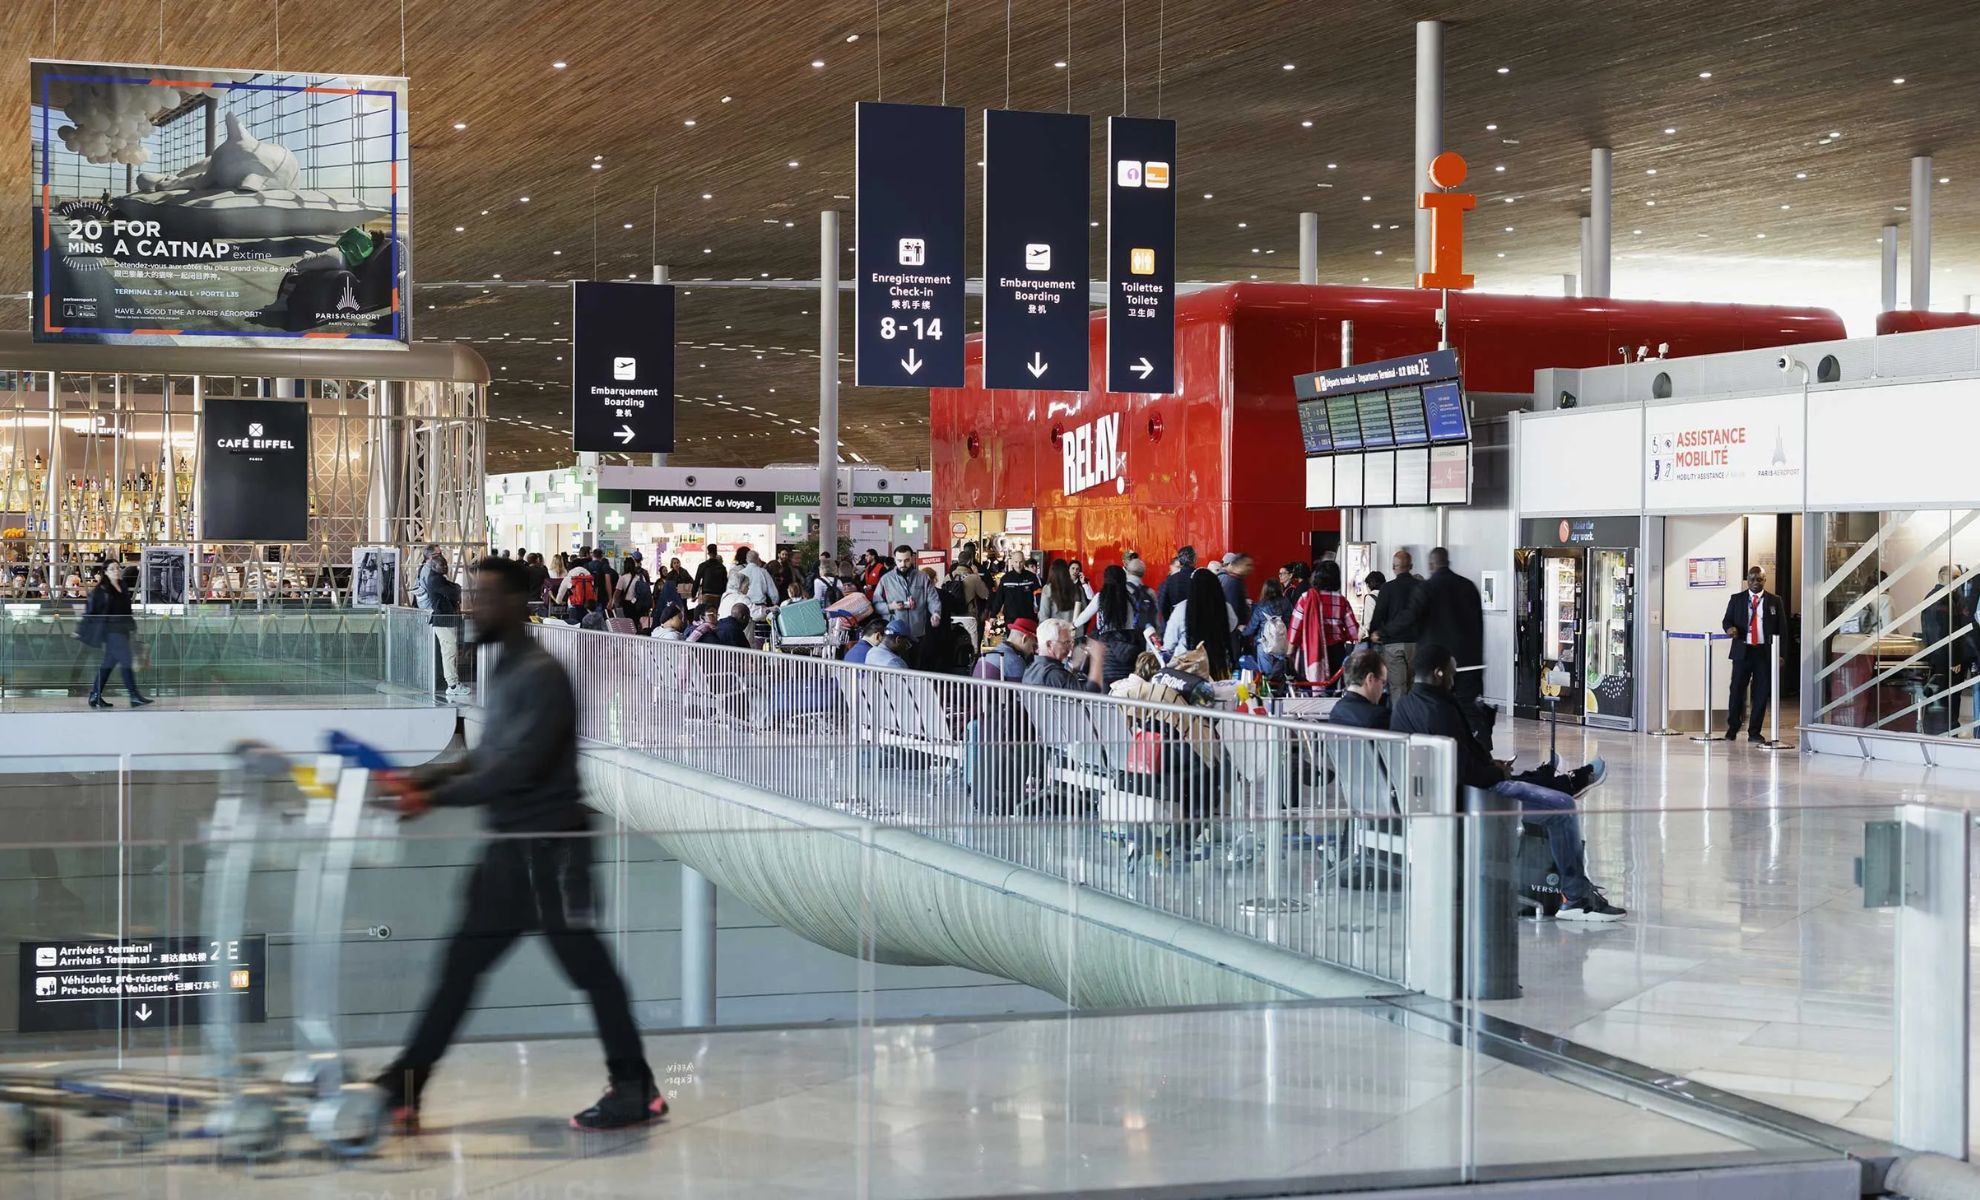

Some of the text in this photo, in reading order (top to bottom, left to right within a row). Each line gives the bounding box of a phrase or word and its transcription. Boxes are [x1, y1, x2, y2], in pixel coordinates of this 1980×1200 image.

[68, 220, 102, 240] 20
[114, 220, 160, 237] FOR
[68, 242, 103, 254] MINS
[113, 238, 230, 258] A CATNAP
[114, 262, 166, 270] Détendez-vous
[872, 273, 951, 286] Enregistrement
[1000, 278, 1075, 291] Embarquement
[889, 286, 934, 297] Check-in
[1122, 282, 1163, 292] Toilettes
[1015, 291, 1060, 303] Boarding
[1126, 295, 1158, 305] Toilets
[1028, 304, 1046, 314] 登机
[1128, 308, 1155, 318] 卫生间
[340, 312, 381, 320] AÉROPORT
[1418, 358, 1430, 376] 2E
[591, 386, 658, 399] Embarquement
[604, 398, 645, 408] Boarding
[217, 437, 294, 449] CAFÉ EIFFEL
[1676, 428, 1746, 448] ASSISTANCE
[1676, 446, 1728, 467] MOBILITÉ
[648, 495, 712, 507] PHARMACIE
[715, 498, 725, 508] du
[726, 499, 754, 510] Voyage
[60, 944, 152, 956] Arrivées terminal
[60, 956, 101, 966] Arrivals
[105, 954, 150, 964] Terminal
[61, 971, 180, 984] Véhicules pré-réservés
[61, 984, 121, 995] Pre-booked
[125, 983, 168, 993] Vehicles
